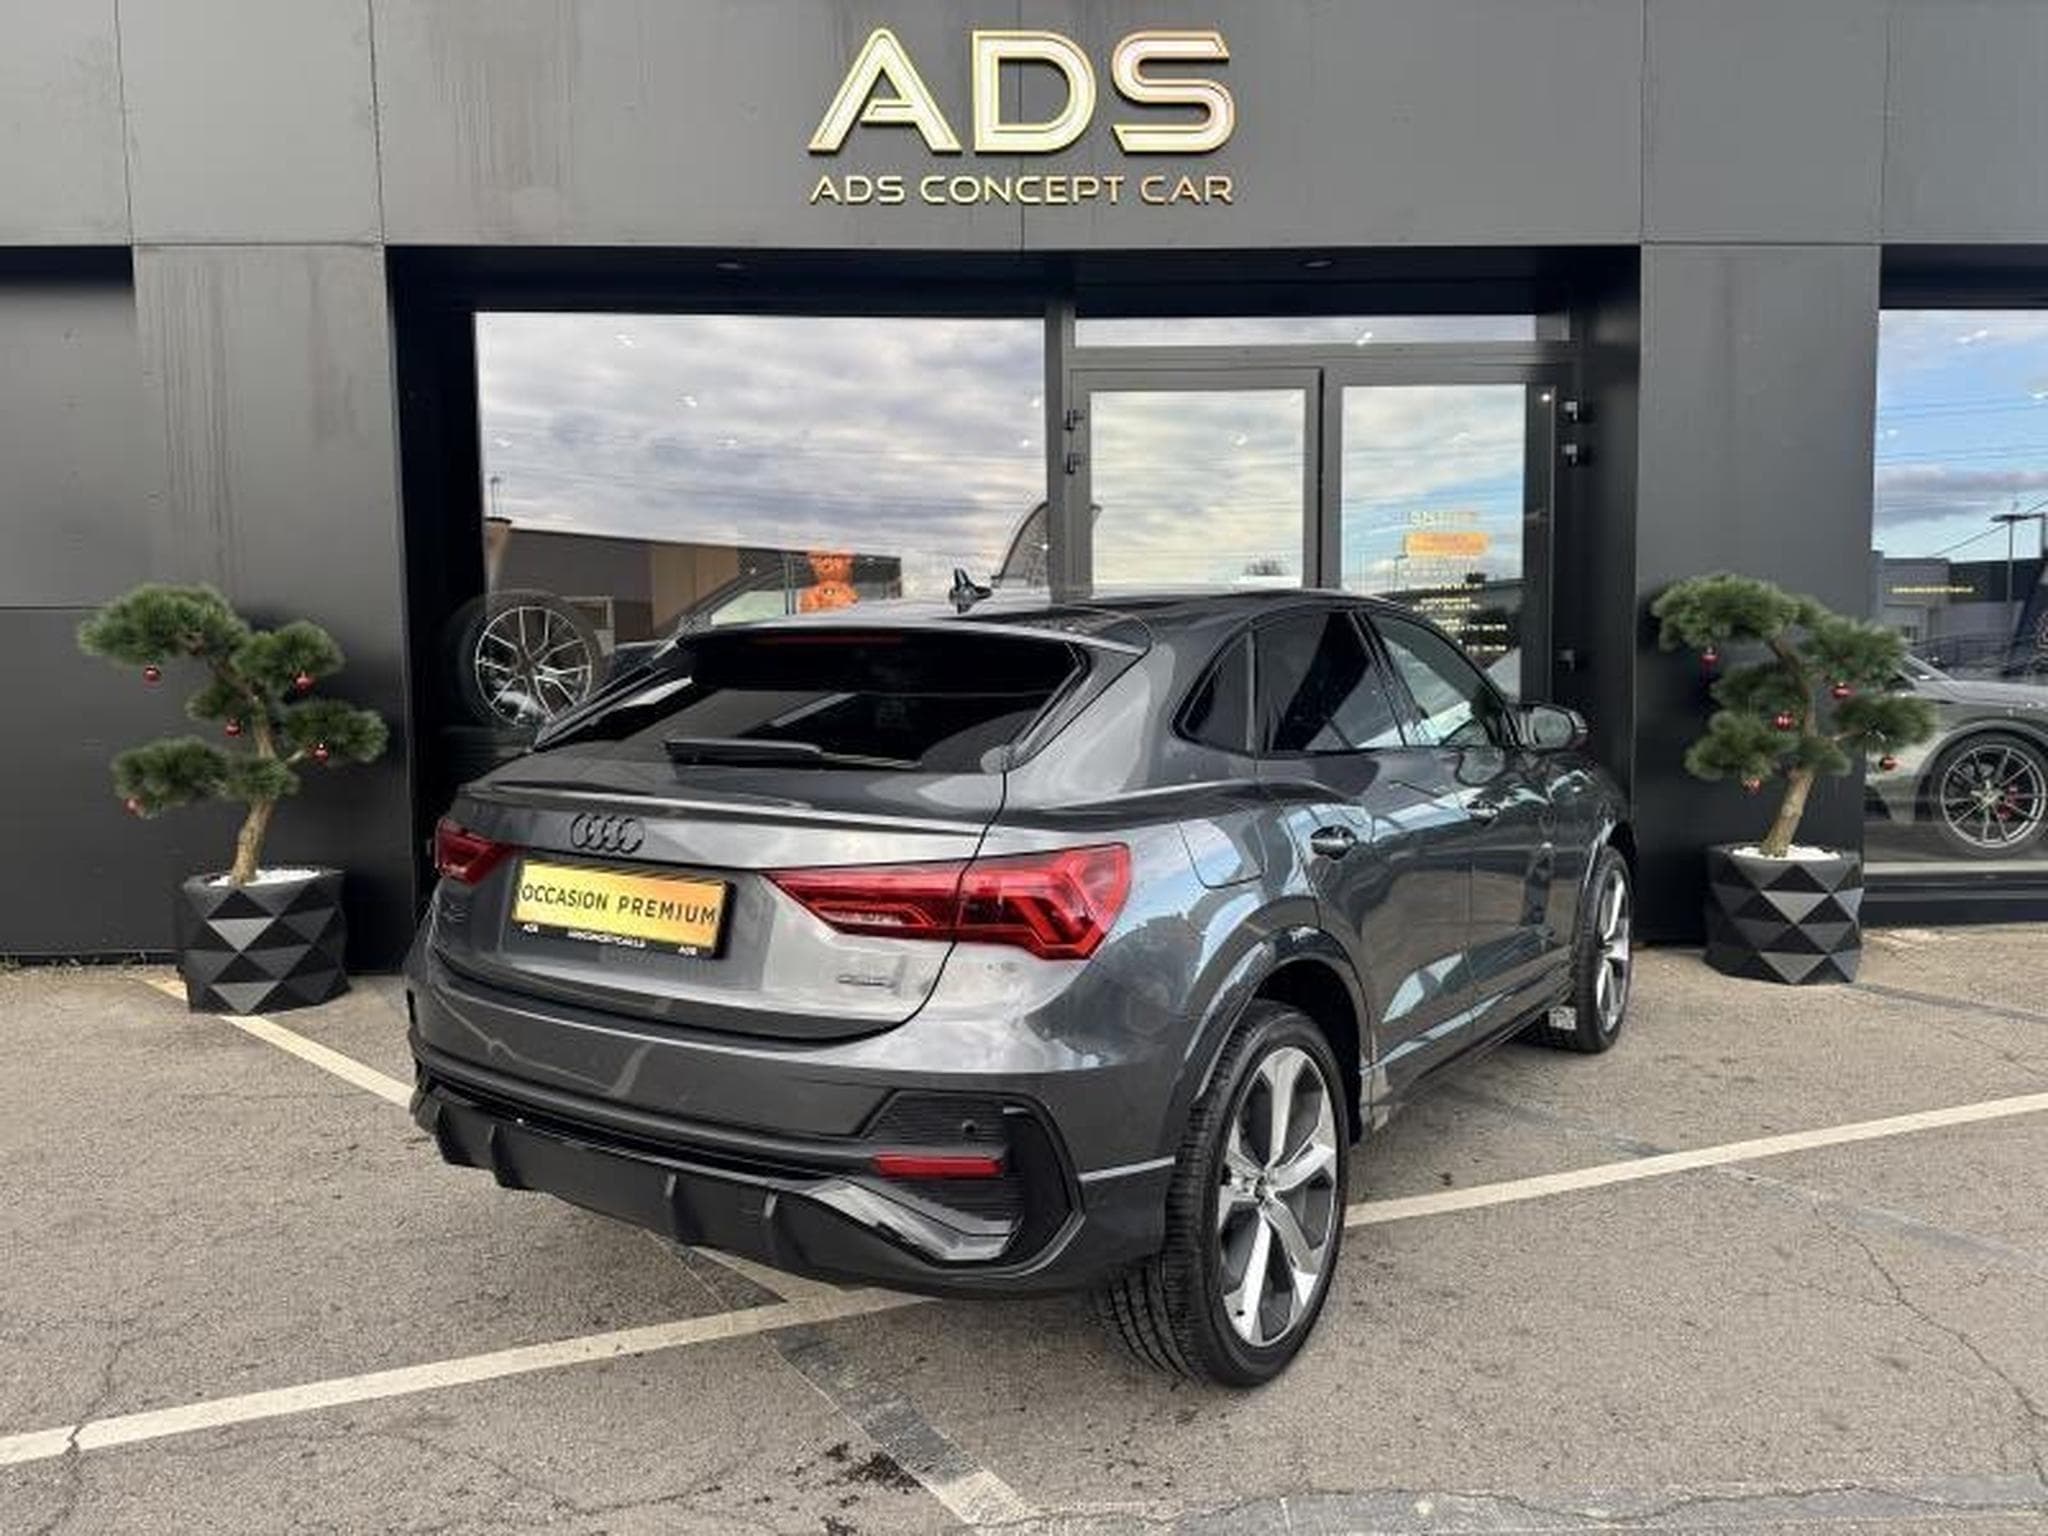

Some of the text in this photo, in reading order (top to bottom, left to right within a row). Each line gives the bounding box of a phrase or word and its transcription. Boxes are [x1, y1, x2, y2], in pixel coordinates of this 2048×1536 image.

[809, 29, 1235, 152] ADS
[810, 176, 1235, 204] ADS CONCEPT CAR
[520, 884, 717, 926] OCCASION PREMIUM
